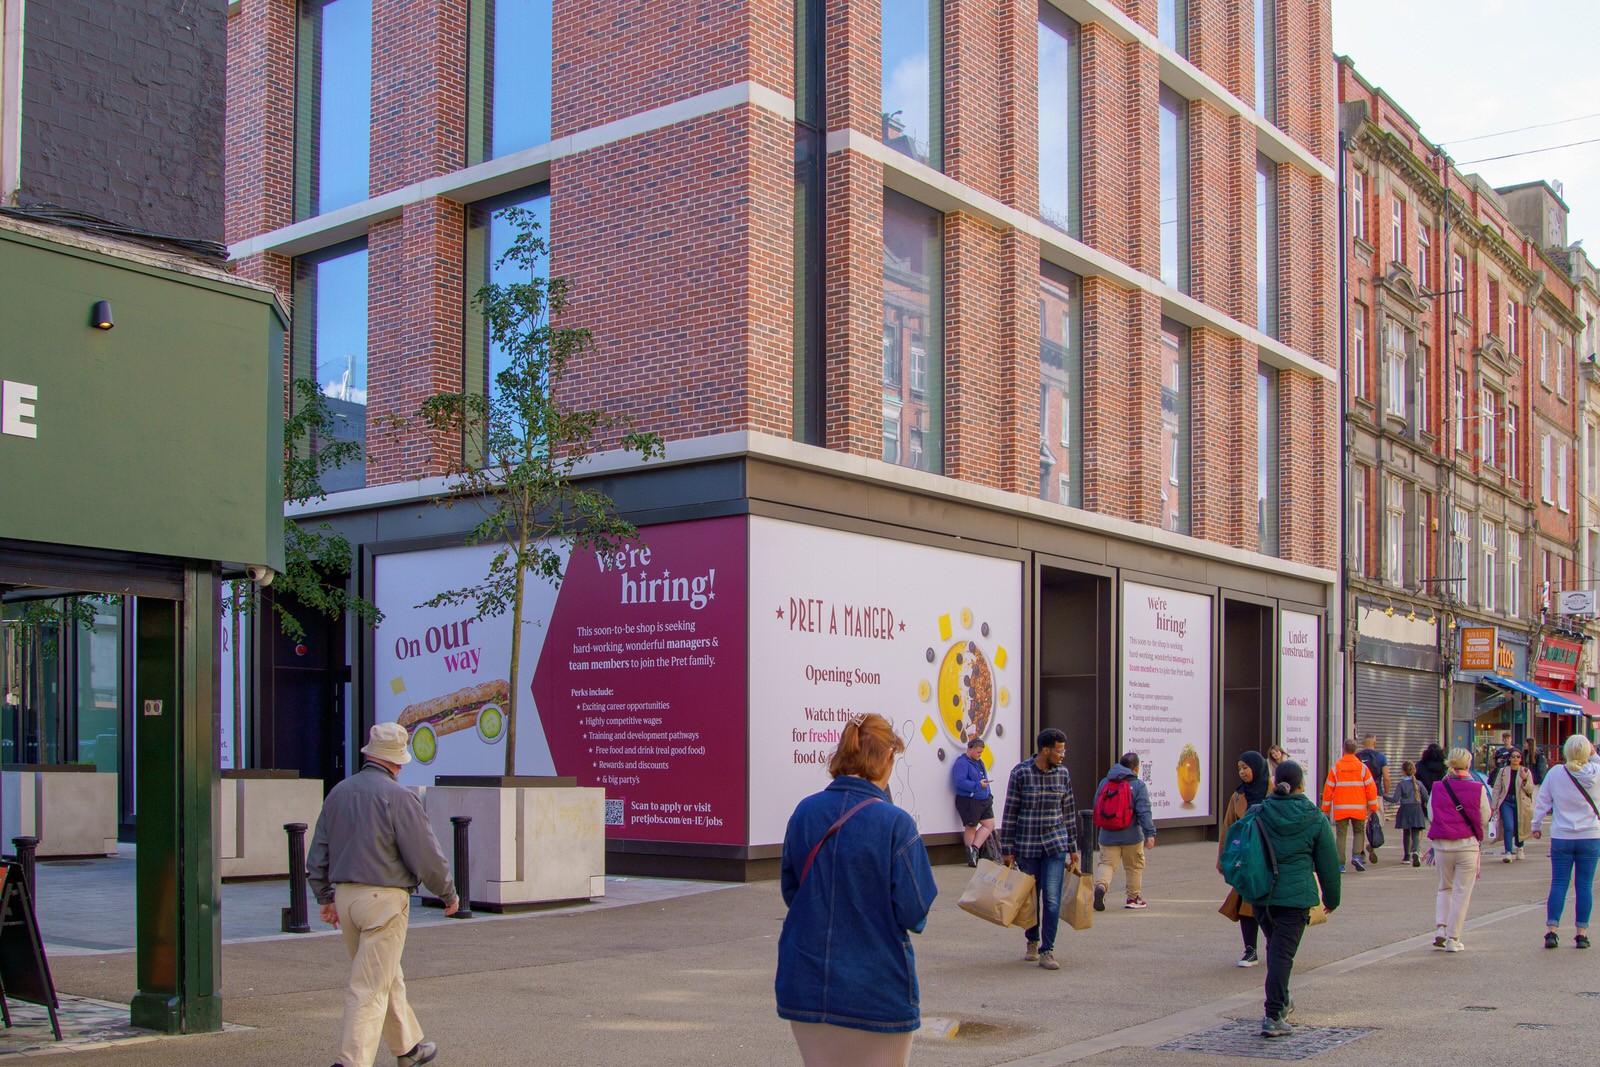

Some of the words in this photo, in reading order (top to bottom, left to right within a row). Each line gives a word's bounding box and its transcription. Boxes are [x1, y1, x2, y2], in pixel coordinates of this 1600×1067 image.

[595, 544, 651, 572] We're
[621, 569, 715, 610] hiring!
[1148, 597, 1167, 610] We're
[790, 597, 823, 633] PRET
[830, 603, 837, 634] A
[845, 604, 894, 640] MANGER
[577, 627, 592, 636] This
[594, 624, 634, 635] soon-to-be
[636, 623, 655, 634] shop
[657, 622, 663, 631] is
[665, 620, 695, 632] seeking
[1157, 613, 1186, 638] hiring!
[396, 637, 421, 660] On
[425, 617, 474, 653] our
[1289, 631, 1308, 644] Under
[573, 642, 624, 654] hard-working,
[626, 639, 664, 651] wonderful
[667, 638, 710, 650] managers
[712, 637, 718, 646] &
[1282, 647, 1314, 659] construction
[444, 648, 481, 674] way
[569, 661, 589, 670] team
[591, 659, 629, 670] members
[631, 659, 638, 668] to
[640, 657, 654, 670] join
[657, 657, 669, 666] the
[671, 656, 687, 666] Pret
[689, 655, 715, 667] family.
[806, 665, 853, 687] Opening
[855, 668, 880, 684] Soon
[582, 703, 605, 712] Exciting
[627, 701, 669, 711] opportunities
[805, 708, 834, 721] Watch
[837, 709, 854, 721] this
[586, 717, 605, 726] Highly
[606, 717, 642, 726] competitive
[643, 717, 662, 726] wages
[589, 732, 613, 741] Training
[627, 732, 667, 740] development
[669, 731, 699, 740] pathways
[792, 728, 807, 742] for
[638, 746, 654, 754] drink
[656, 746, 669, 754] (real
[671, 746, 687, 756] good
[688, 746, 705, 755] food)
[794, 750, 816, 764] food
[818, 750, 825, 764] &
[638, 761, 669, 770] discounts
[608, 775, 618, 785] big
[619, 776, 640, 785] party's
[631, 801, 649, 810] Scan
[660, 802, 681, 813] apply
[694, 803, 711, 812] visit
[631, 815, 723, 827] pretjobs.com/en-IE/jobs
